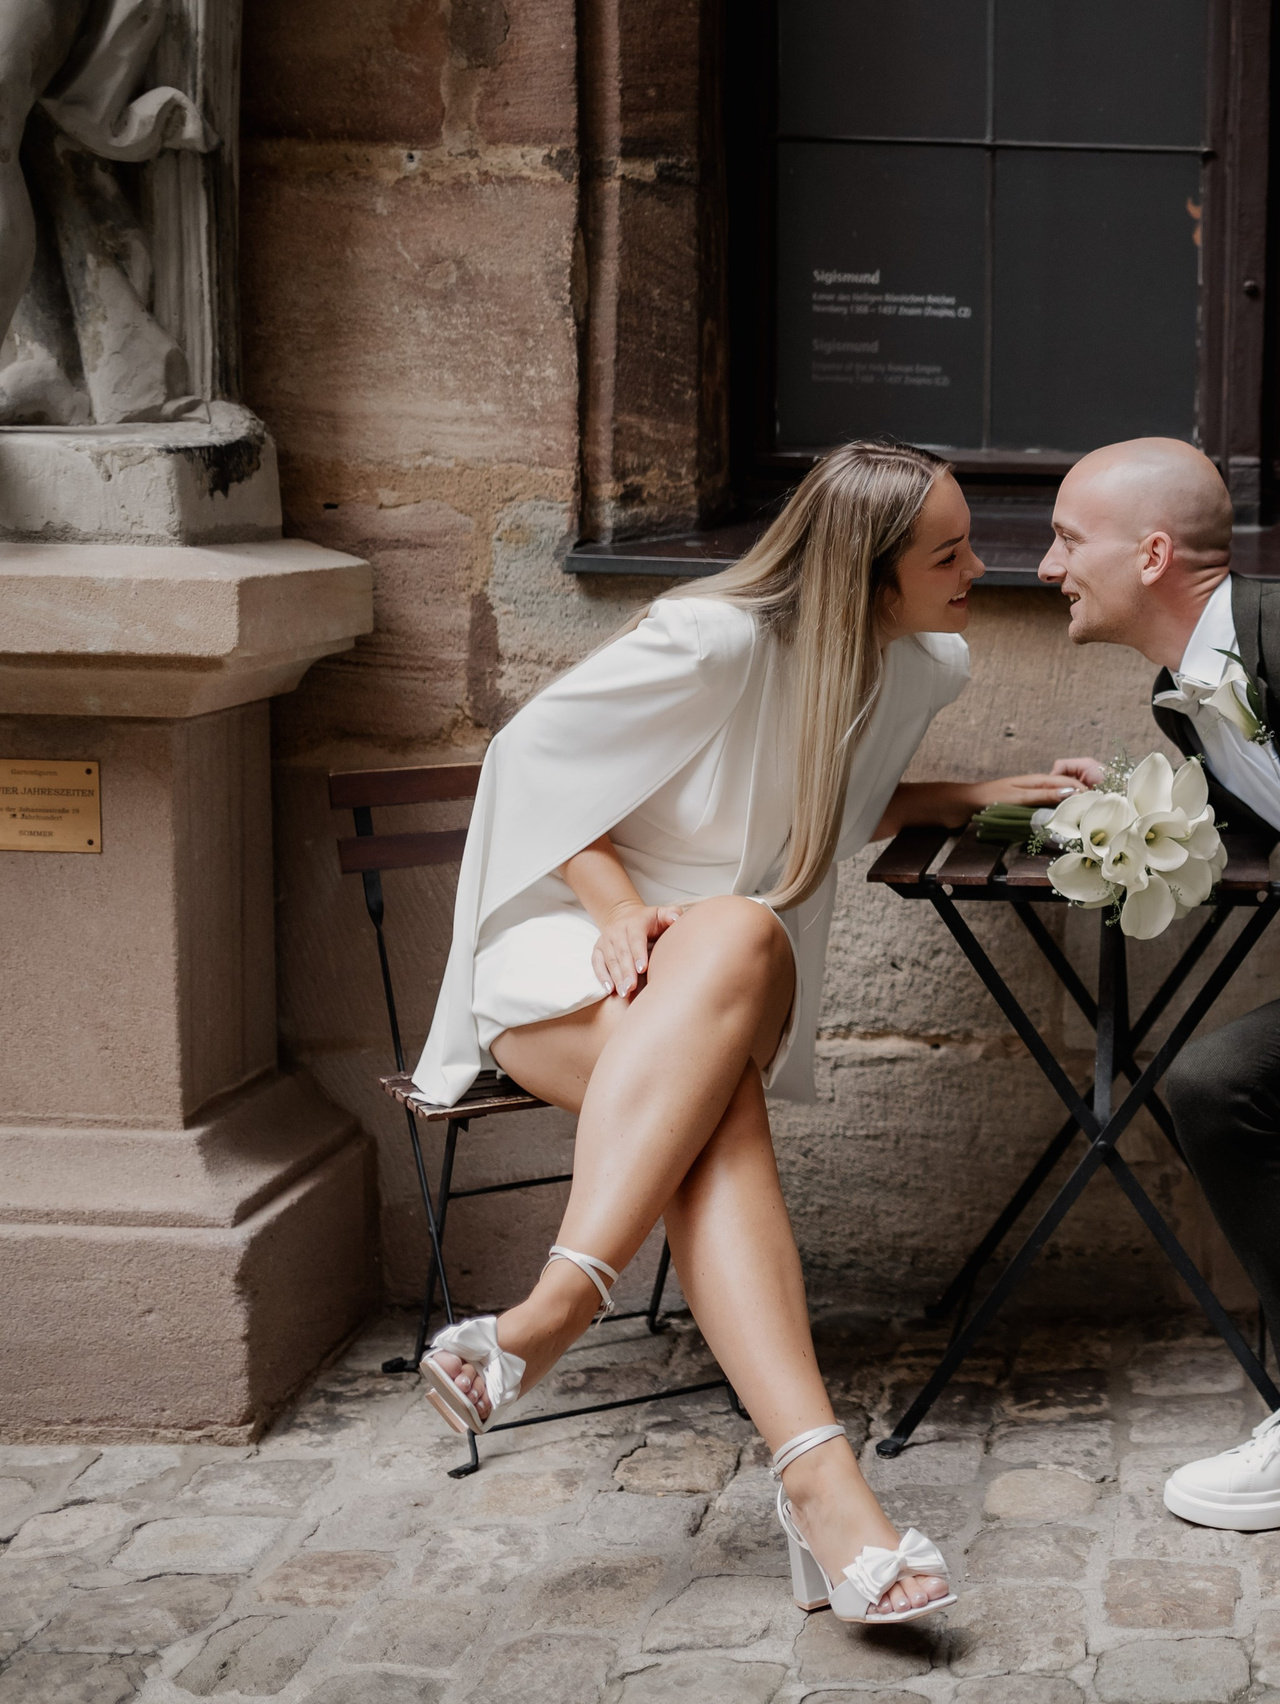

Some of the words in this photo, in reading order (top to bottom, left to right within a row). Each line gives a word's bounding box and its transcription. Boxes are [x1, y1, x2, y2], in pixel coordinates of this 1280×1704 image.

[813, 268, 881, 286] Sigismund
[812, 338, 880, 355] Sigismund
[20, 786, 95, 798] JAHRESZEITEN
[18, 829, 54, 837] SOMMER
